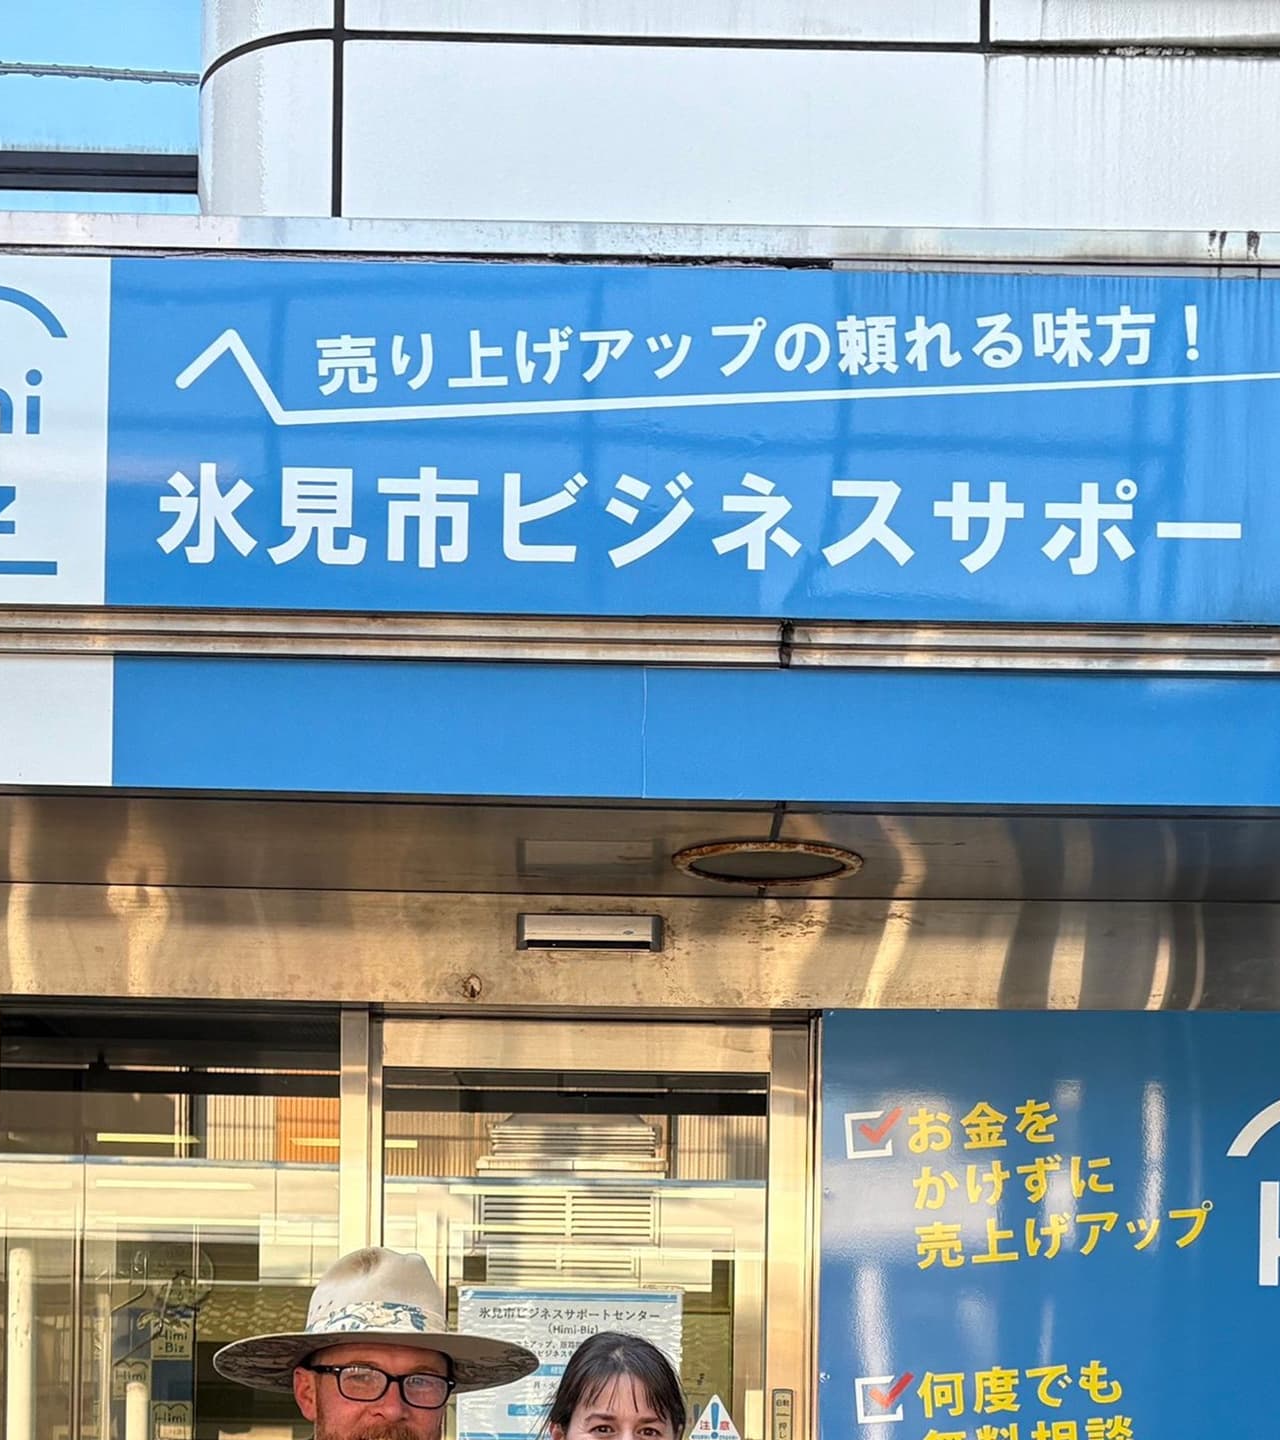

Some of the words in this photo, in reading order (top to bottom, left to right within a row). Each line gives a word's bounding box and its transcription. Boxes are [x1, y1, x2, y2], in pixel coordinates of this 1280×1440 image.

[316, 304, 1202, 396] 売り上げアップの頼れる味方！
[908, 1098, 1059, 1154] お金を
[914, 1156, 1114, 1211] かけずに
[916, 1199, 1213, 1270] 売上げアップ
[154, 1411, 186, 1423] Himi
[917, 1360, 1123, 1418] 何度でも
